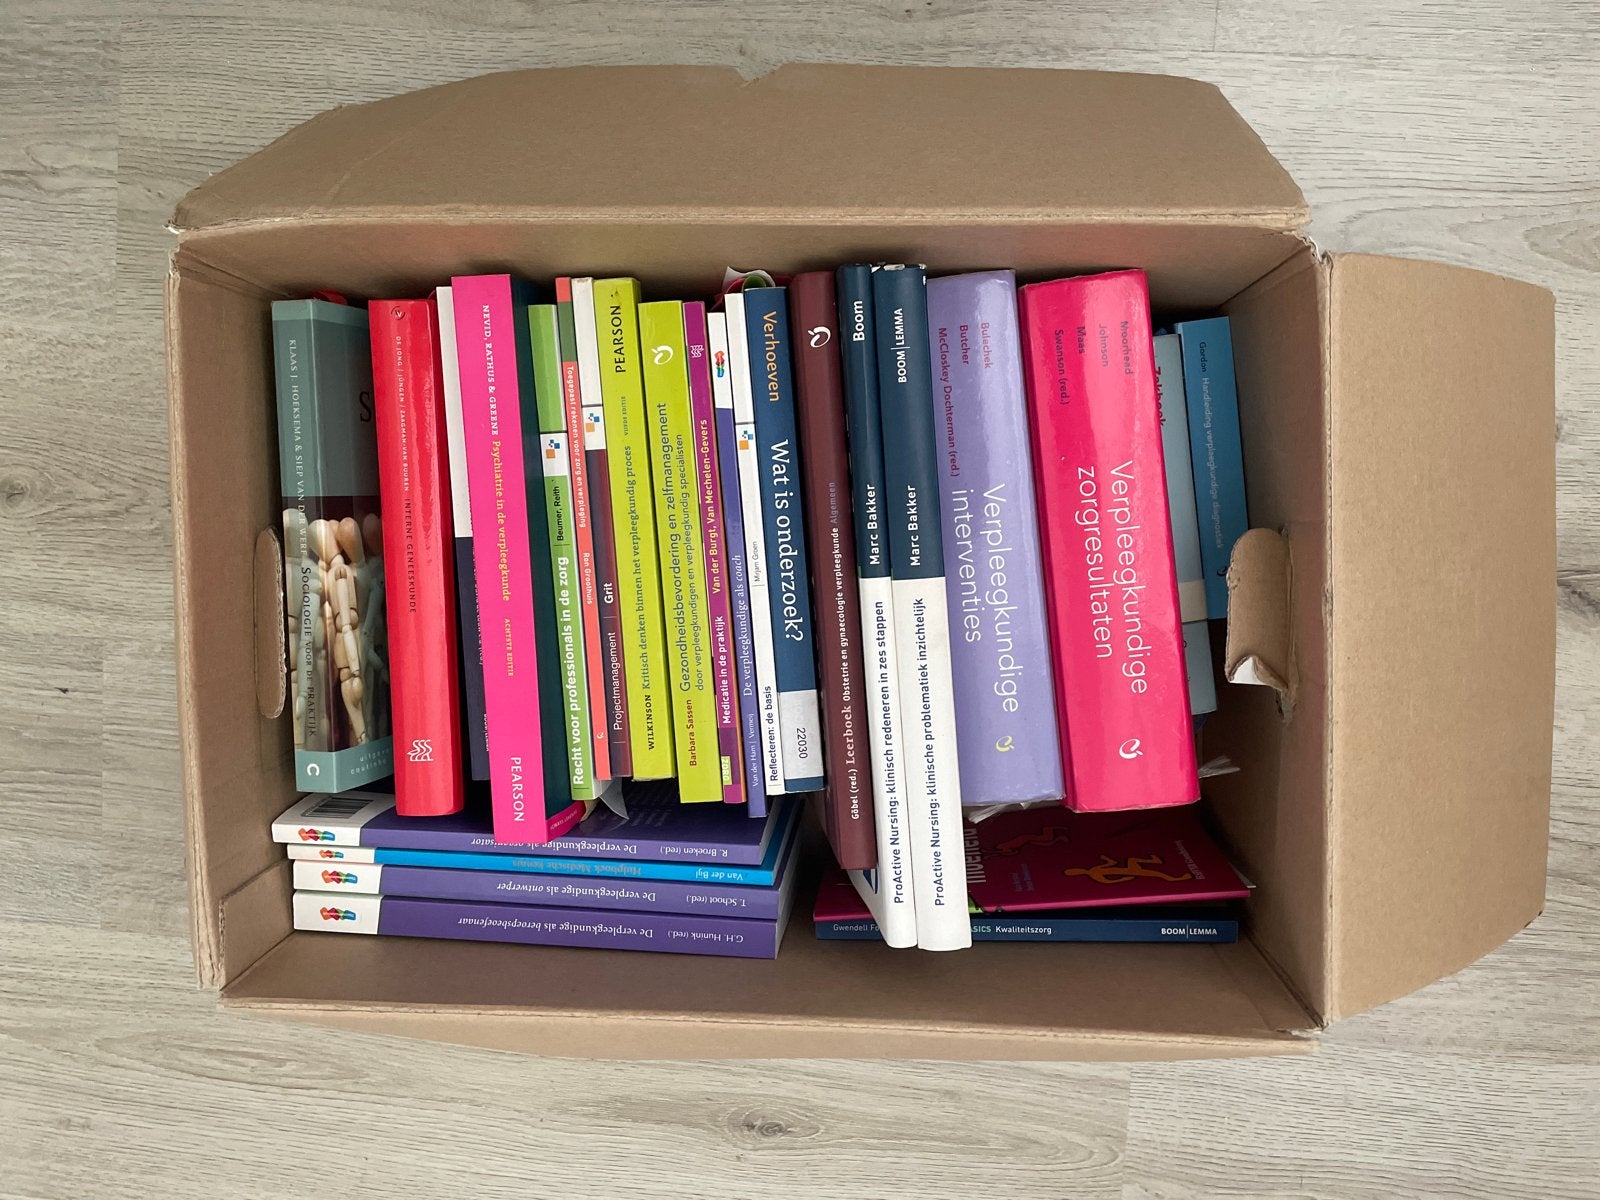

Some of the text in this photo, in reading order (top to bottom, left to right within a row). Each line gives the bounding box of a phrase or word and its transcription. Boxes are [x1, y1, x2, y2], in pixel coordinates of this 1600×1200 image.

[610, 304, 626, 373] PEARSON
[852, 300, 865, 341] Boom
[893, 308, 906, 383] BOOM LEMMA
[959, 324, 969, 365] Butcher
[1076, 326, 1086, 354] Maas
[1099, 323, 1108, 367] Johnson
[1120, 321, 1134, 375] Moorhead
[762, 311, 781, 402] Verhoeven
[1054, 329, 1069, 405] Swanson (red.)
[1199, 341, 1207, 373] Gordon
[400, 410, 409, 460] ZAAGMAN-VAN
[938, 327, 960, 477] McCloskey Dochterman (red.)
[1201, 377, 1213, 428] Handleiding
[289, 339, 308, 556] KLAAS HOEKSEMA SIEP VAN DER WERF
[482, 304, 514, 676] NEVID, RATHUS GREENE Psychiatrie de verpleegkunde ACHTSTE EDITIE
[567, 366, 594, 605] Toegepast rekenen voor zorg verpleging Groothuis
[404, 499, 413, 540] INTERNE
[771, 439, 804, 642] Wat is onderzoek?
[866, 484, 880, 565] Marc Bakker
[906, 485, 921, 567] Marc Bakker
[406, 544, 417, 613] GENEESKUNDE
[658, 403, 697, 767] Barbara Sassen Gezondheidsbevordering en zelfmanagement
[676, 434, 704, 691] door verpleegkundigen verpleegkundig specialisten
[700, 419, 732, 724] Medicatie de praktijk Van der Burgt, Van Mechelen-Gevers
[733, 554, 743, 582] coach
[735, 583, 744, 597] als
[751, 541, 762, 582] Mirjam Groen
[951, 489, 986, 643] interventies
[1075, 466, 1114, 659] zorgresultaten
[1107, 460, 1152, 694] Verpleegkundige
[624, 446, 655, 750] WILKINSON Kritisch denken binnen het verpleegkundig proces
[980, 483, 1024, 713] Verpleegkundige
[553, 486, 585, 785] Recht voor professionals in de zorg Beumer, Reith
[603, 582, 624, 731] Projectmanagement Grit
[735, 599, 752, 680] verpleegkundige
[828, 482, 860, 820] Göbel (red.) Leerboek Obstetrie gynaecologie verpleegkunde Algemeen
[743, 681, 752, 697] De
[763, 685, 779, 782] Reflecteren: de basis
[796, 727, 808, 759] 22030
[876, 601, 904, 903] ProActive Nursing: klinisch redeneren zes stappen
[913, 597, 945, 906] ProActive Nursing: klinische problematiek inzichtelijk
[511, 757, 524, 822] PEARSON
[542, 838, 621, 853] verpleegkundige
[546, 861, 591, 874] Medische
[623, 844, 637, 854] De
[660, 845, 681, 855] (red.)
[683, 847, 717, 857] Broeken
[695, 868, 709, 879] Bijl
[710, 871, 725, 880] der
[727, 871, 743, 881] Van
[496, 881, 738, 906] Schoot (red.) De verpleegkundige als ontwerper
[458, 916, 744, 943] G.H. Hunink (red.) De verpleegkundige als beroepsbeoefenaar
[833, 923, 868, 932] Gwendell
[995, 925, 1052, 936] Kwaliteitszorg
[1161, 927, 1218, 936] BOOM LEMMA
